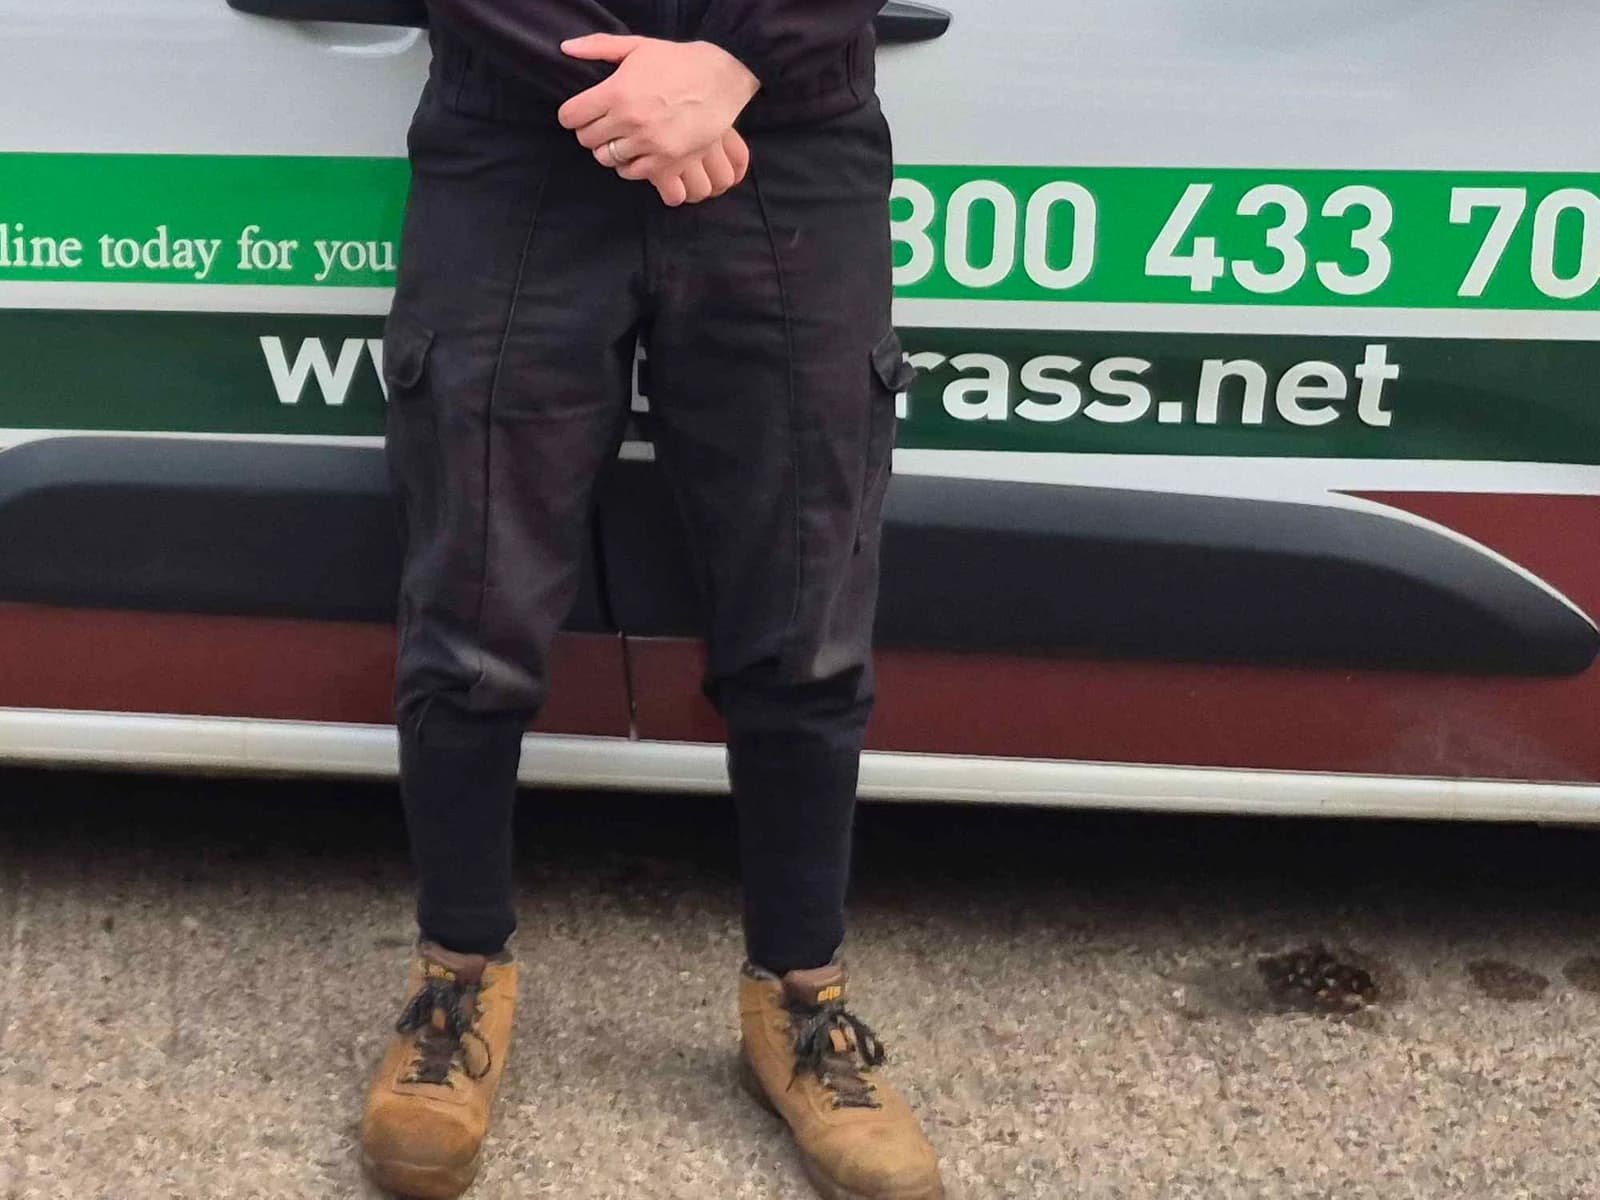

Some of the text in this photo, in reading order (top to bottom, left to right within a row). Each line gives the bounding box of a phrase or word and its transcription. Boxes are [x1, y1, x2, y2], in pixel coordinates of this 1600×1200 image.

[99, 224, 221, 279] today
[237, 225, 299, 271] for
[1145, 184, 1393, 295] 433
[1449, 187, 1600, 299] 70
